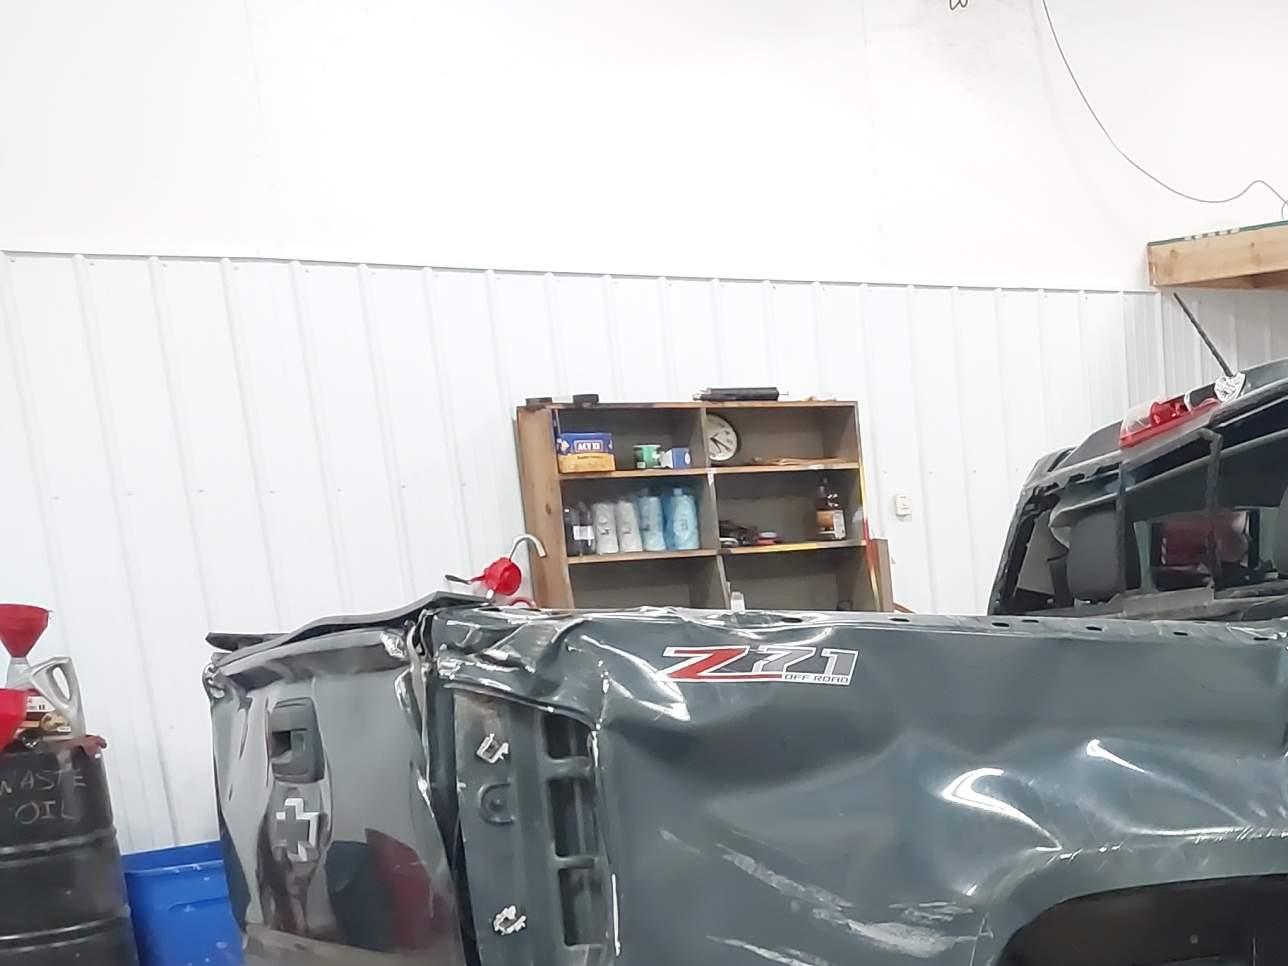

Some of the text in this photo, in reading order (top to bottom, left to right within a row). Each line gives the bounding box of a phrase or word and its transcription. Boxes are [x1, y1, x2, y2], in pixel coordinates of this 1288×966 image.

[655, 645, 859, 685] Z71
[813, 675, 849, 684] ROAD
[15, 800, 79, 825] OIL
